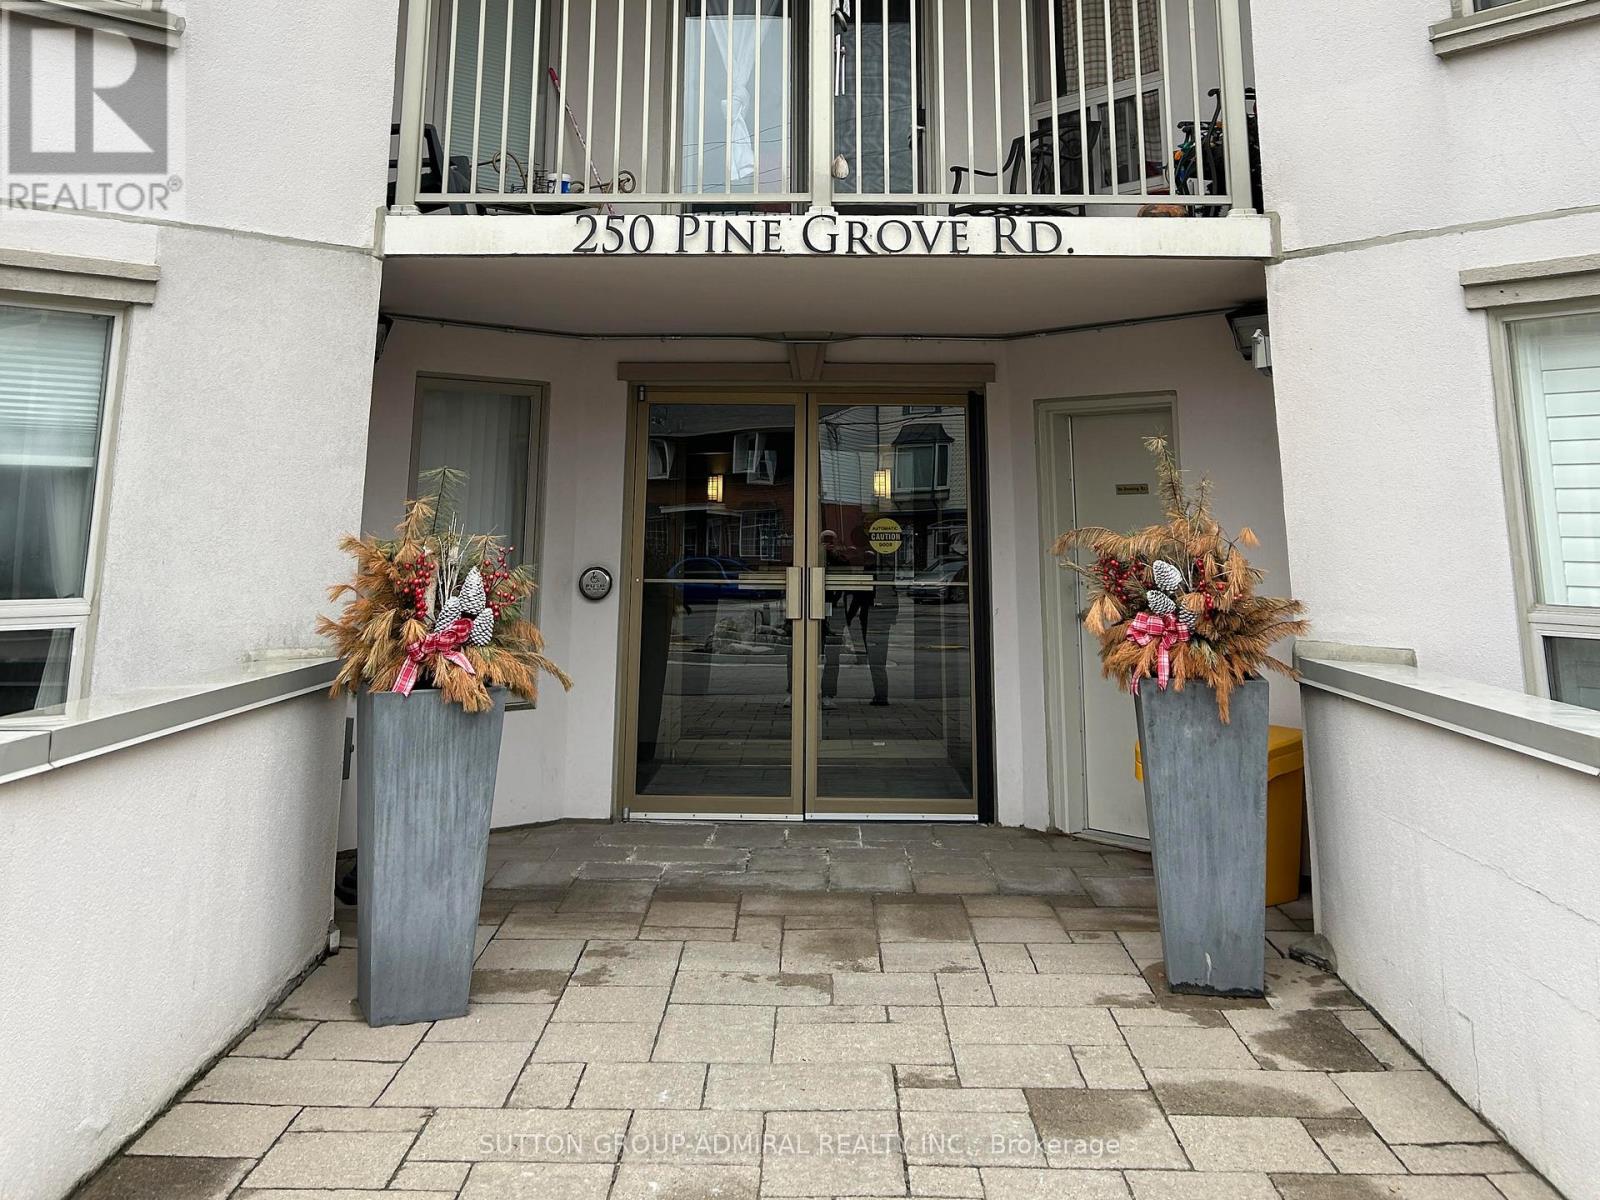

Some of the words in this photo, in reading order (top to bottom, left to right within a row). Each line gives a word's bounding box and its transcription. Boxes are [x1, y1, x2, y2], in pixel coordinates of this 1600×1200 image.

[572, 214, 655, 253] 250
[675, 214, 783, 253] PINE
[802, 214, 970, 253] GROVE
